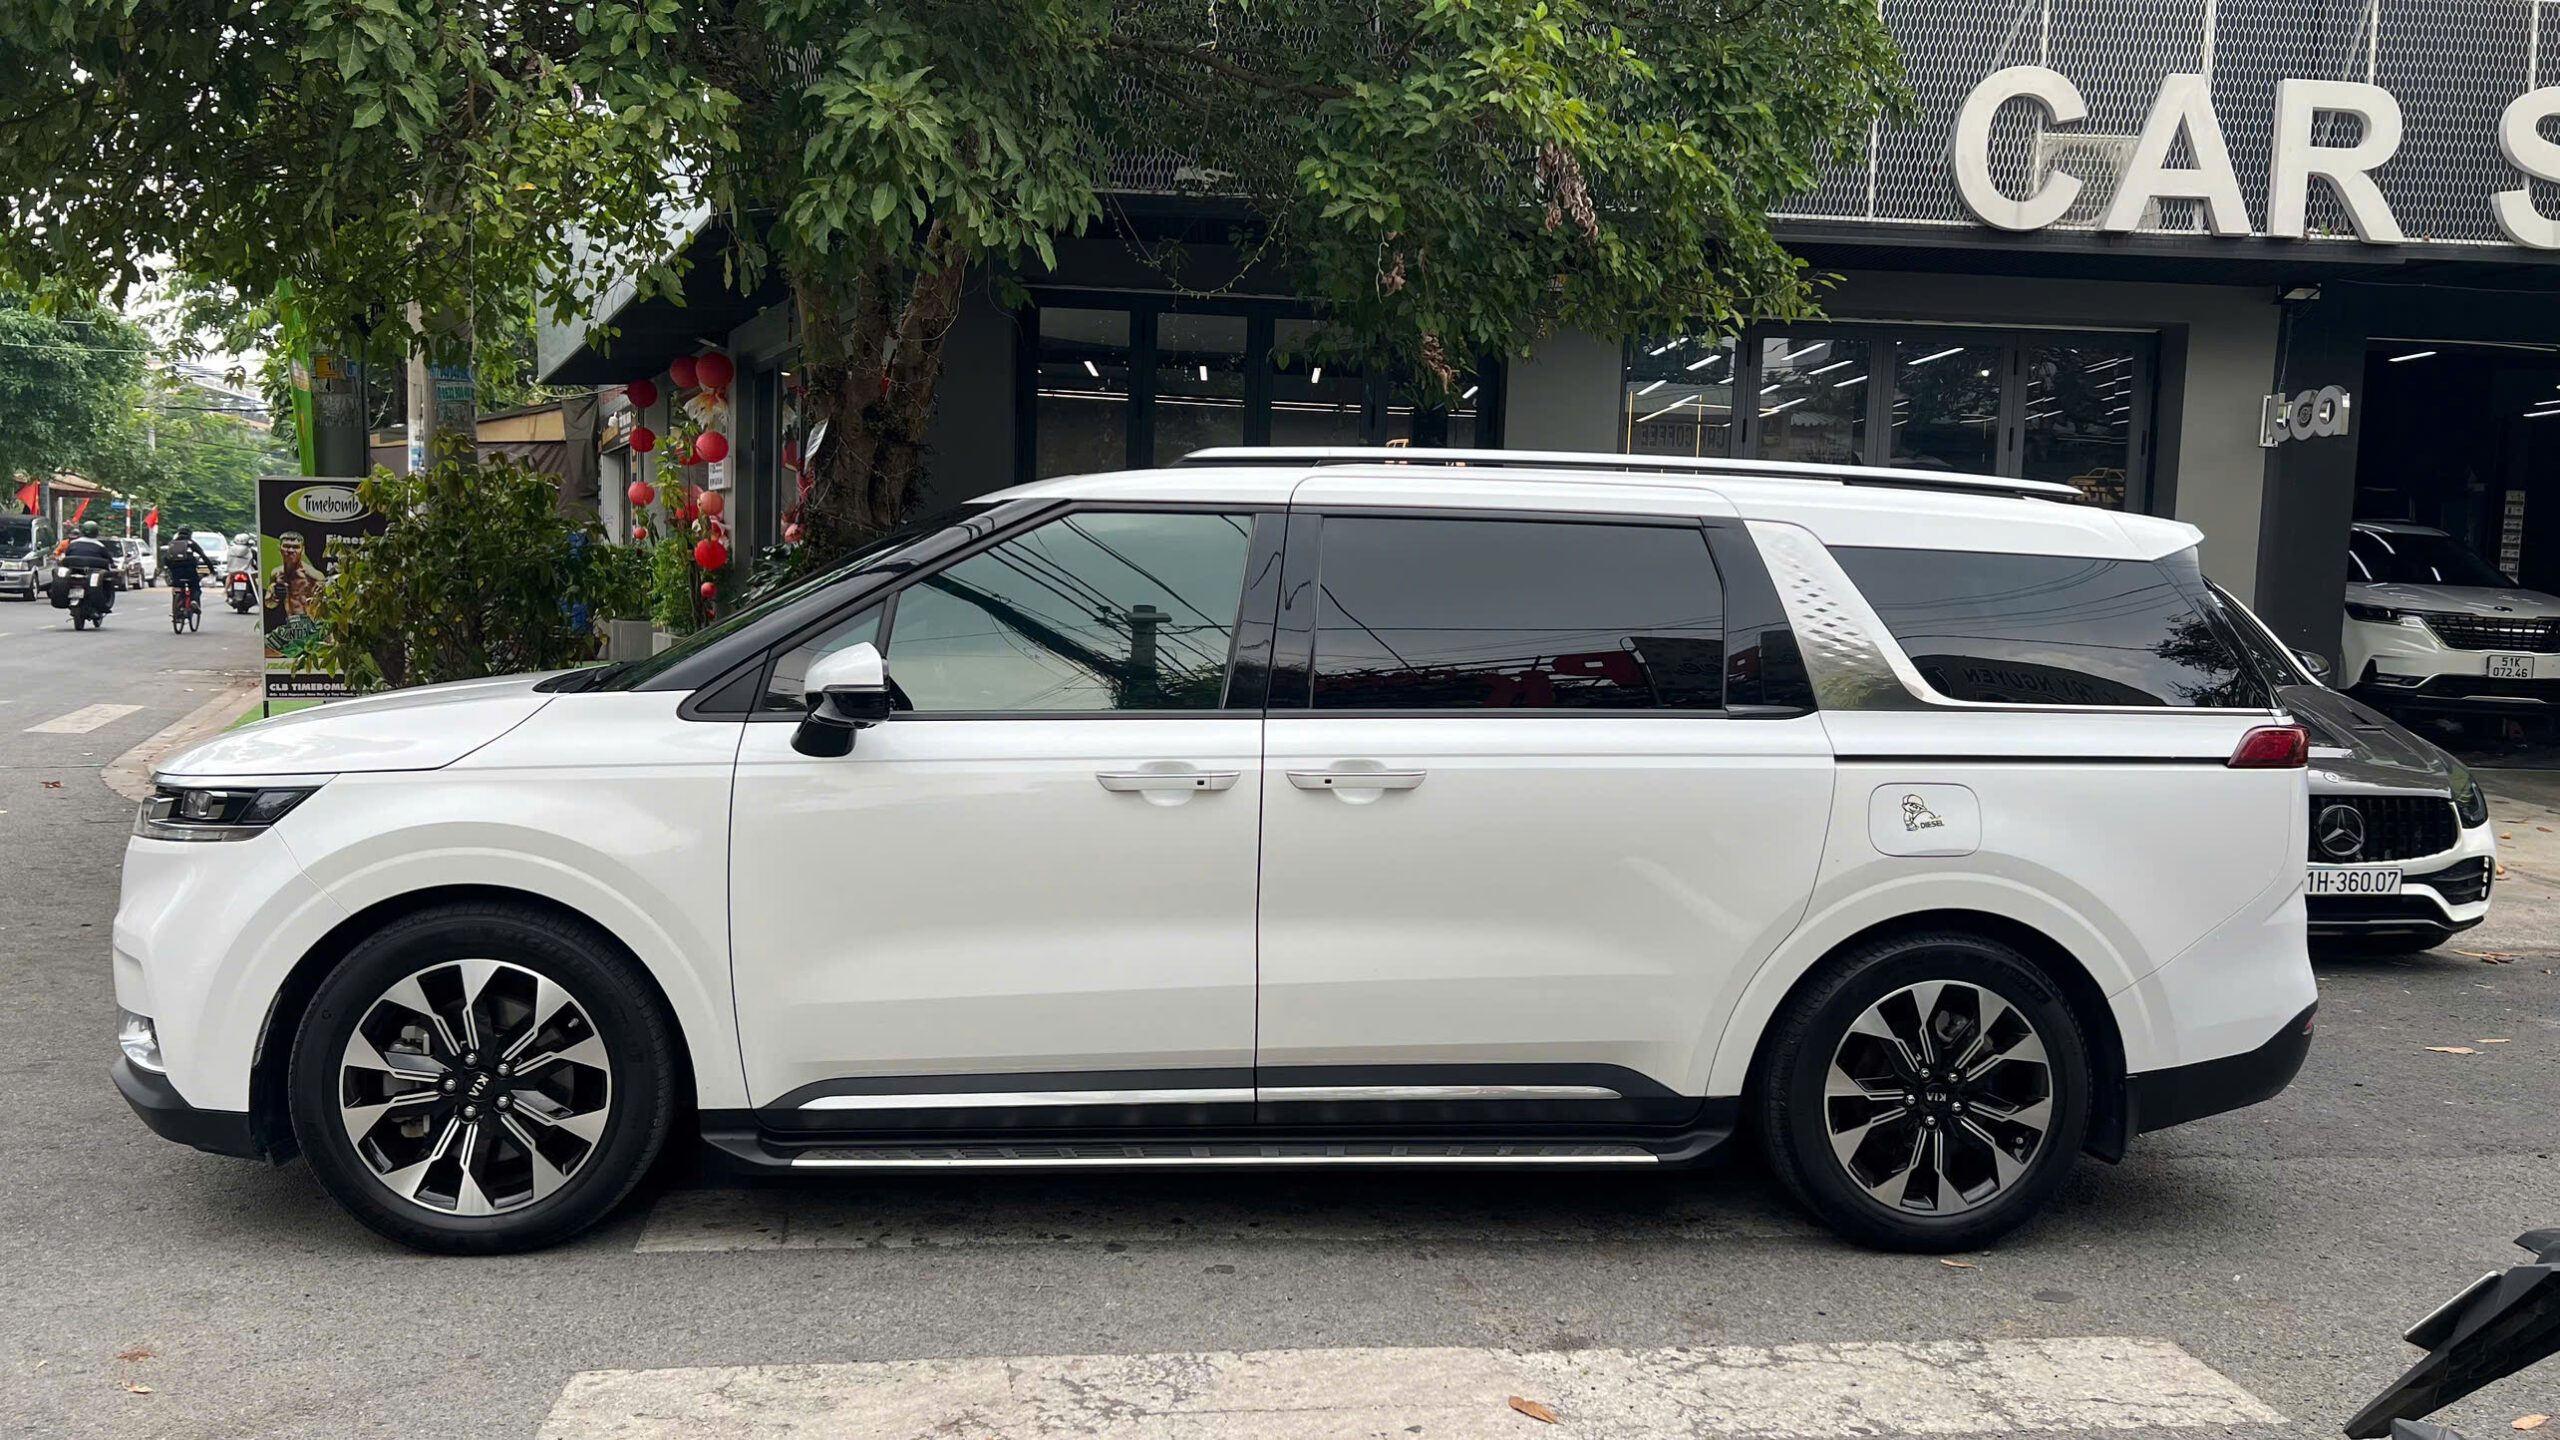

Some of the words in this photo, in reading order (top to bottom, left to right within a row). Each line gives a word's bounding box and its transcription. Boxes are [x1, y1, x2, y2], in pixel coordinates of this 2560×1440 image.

[1952, 65, 2403, 245] CAR
[304, 494, 359, 513] Timebomb
[2502, 657, 2520, 667] 51K
[2493, 667, 2528, 678] 072.46
[269, 683, 289, 691] CLB
[291, 683, 347, 691] TIMEBOMB
[1920, 820, 1944, 829] DIESEL
[2307, 871, 2398, 892] 1H-360.07
